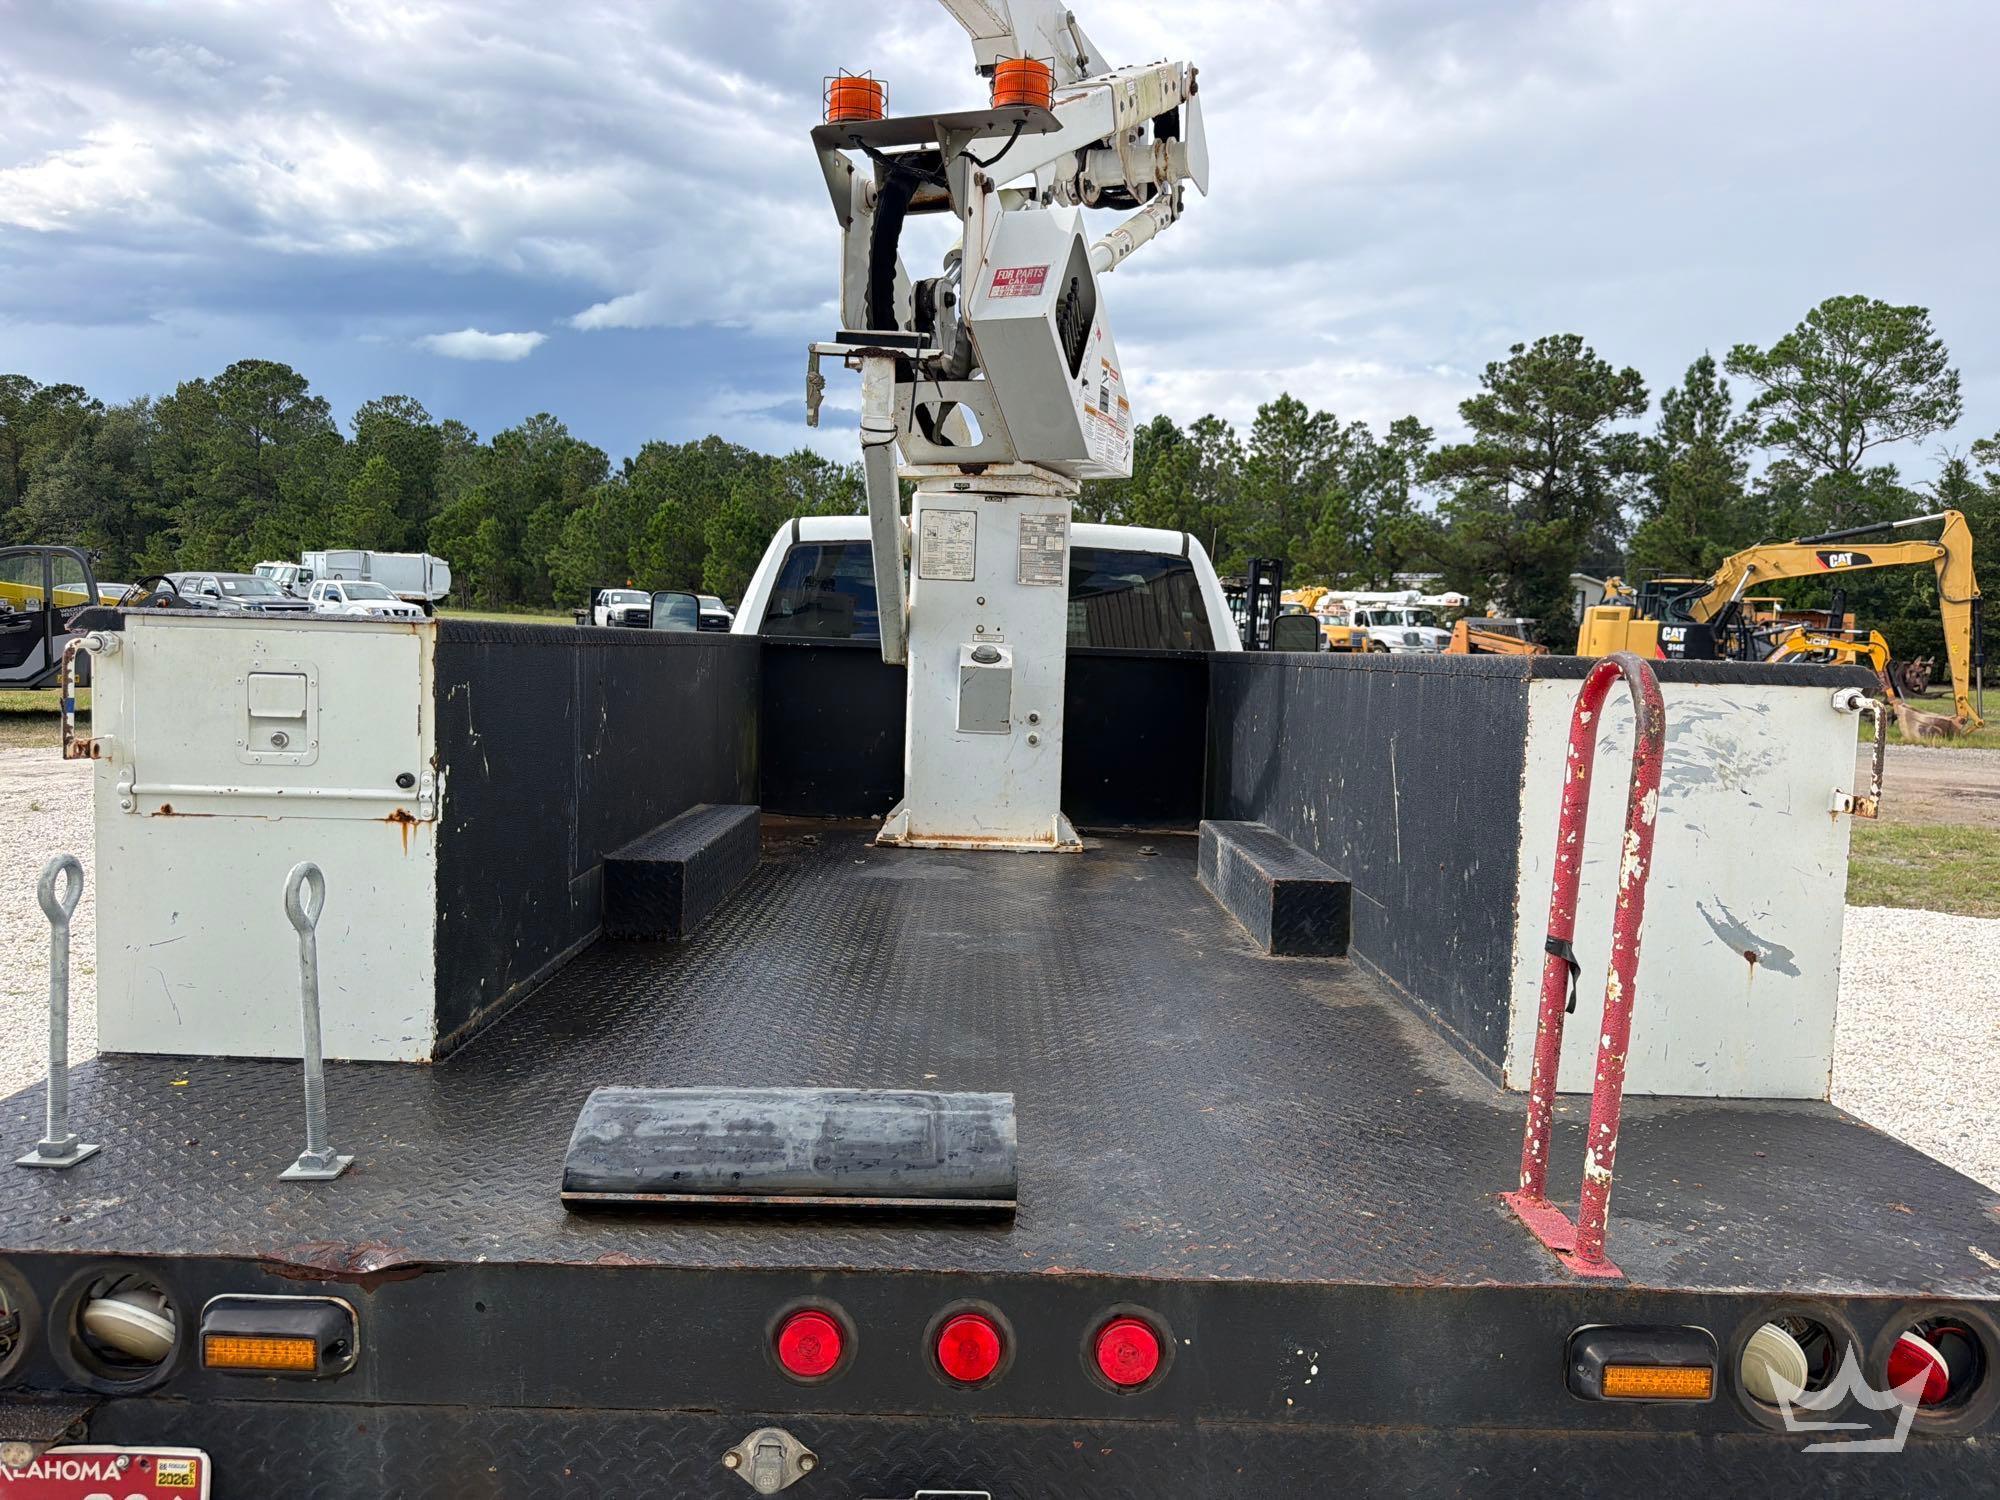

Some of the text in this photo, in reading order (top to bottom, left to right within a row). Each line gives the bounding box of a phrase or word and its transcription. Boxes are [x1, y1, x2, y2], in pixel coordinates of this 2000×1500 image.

[997, 268, 1044, 280] FOR PARTS
[1829, 553, 1853, 568] CAT
[1662, 626, 1687, 641] CAT
[1805, 637, 1829, 646] JCB
[158, 1472, 189, 1485] 2026
